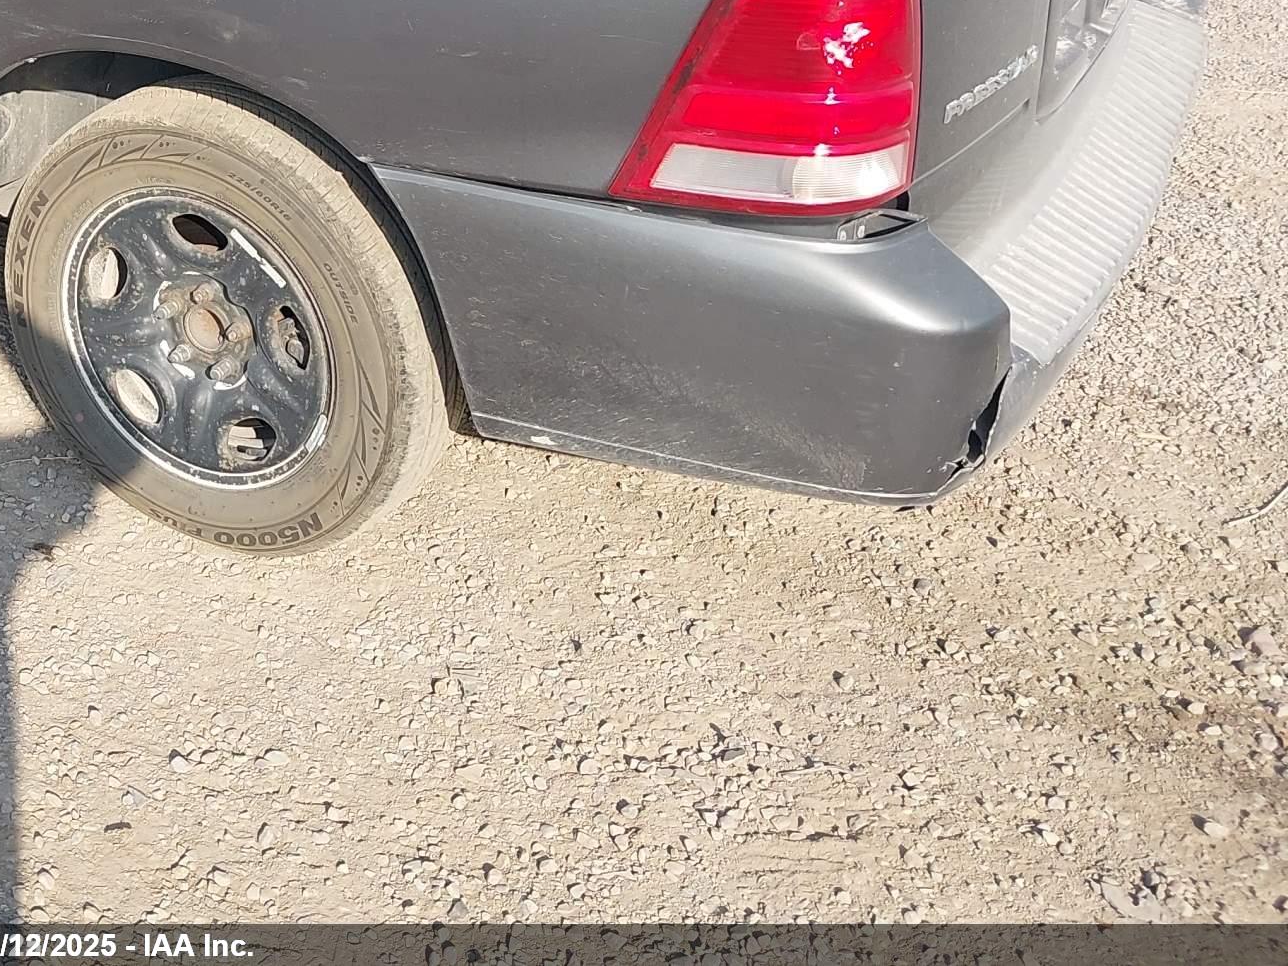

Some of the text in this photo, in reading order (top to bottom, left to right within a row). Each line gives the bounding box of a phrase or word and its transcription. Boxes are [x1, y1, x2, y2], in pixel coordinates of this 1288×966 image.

[13, 189, 50, 328] NEXEN
[322, 262, 360, 325] OUTSIDE
[213, 512, 324, 547] N5000
